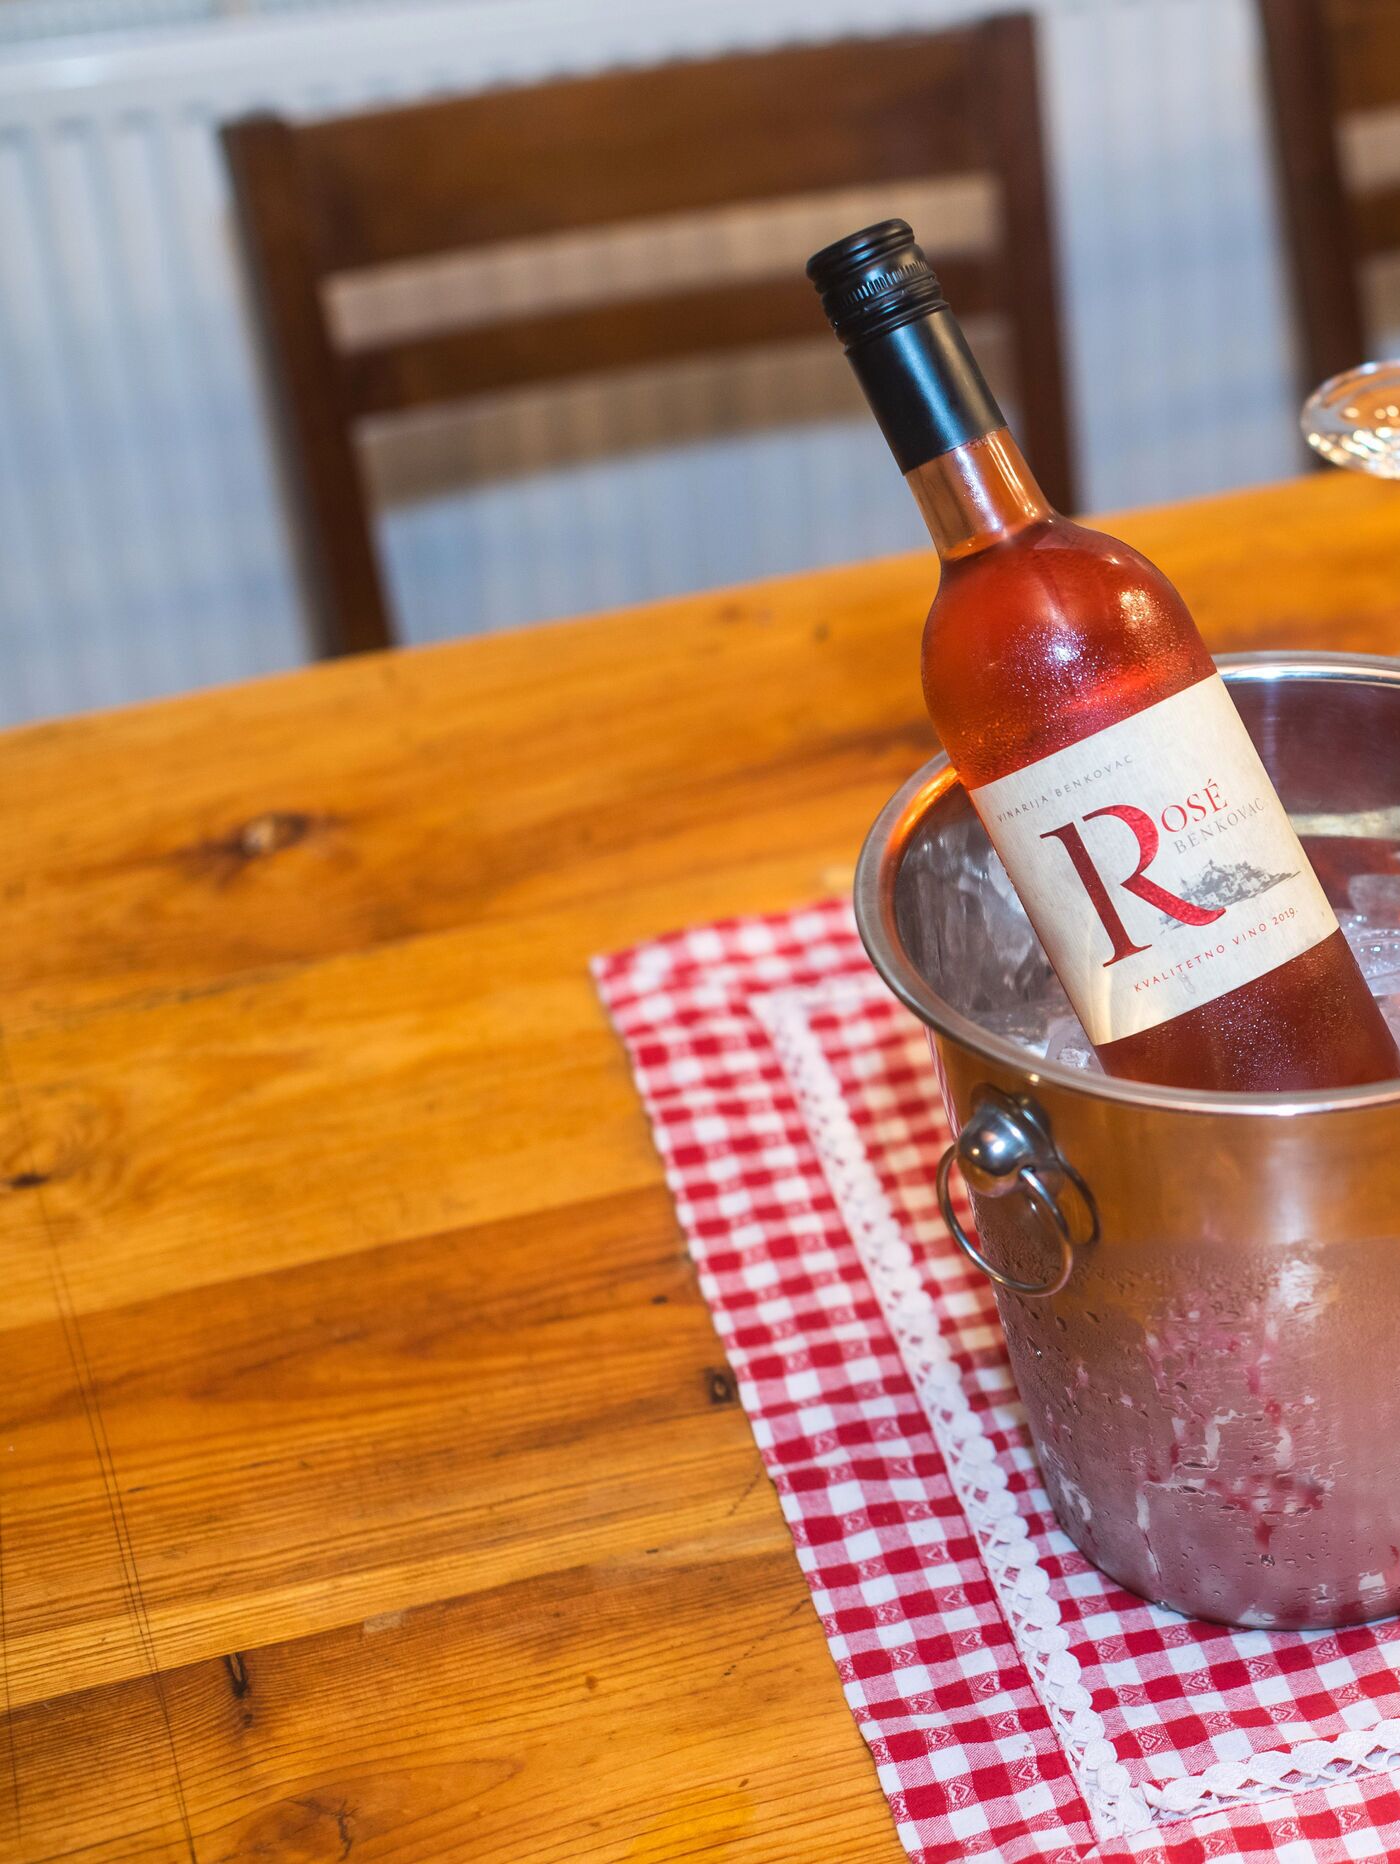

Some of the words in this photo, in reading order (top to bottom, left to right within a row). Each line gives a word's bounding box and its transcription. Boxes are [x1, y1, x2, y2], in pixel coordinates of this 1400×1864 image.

[997, 795, 1049, 823] VINARIJA
[1055, 755, 1133, 797] BENKOVAC
[1173, 797, 1265, 854] BENKOVAC
[1134, 944, 1226, 992] KVALITETNO
[1232, 922, 1267, 945] VINO
